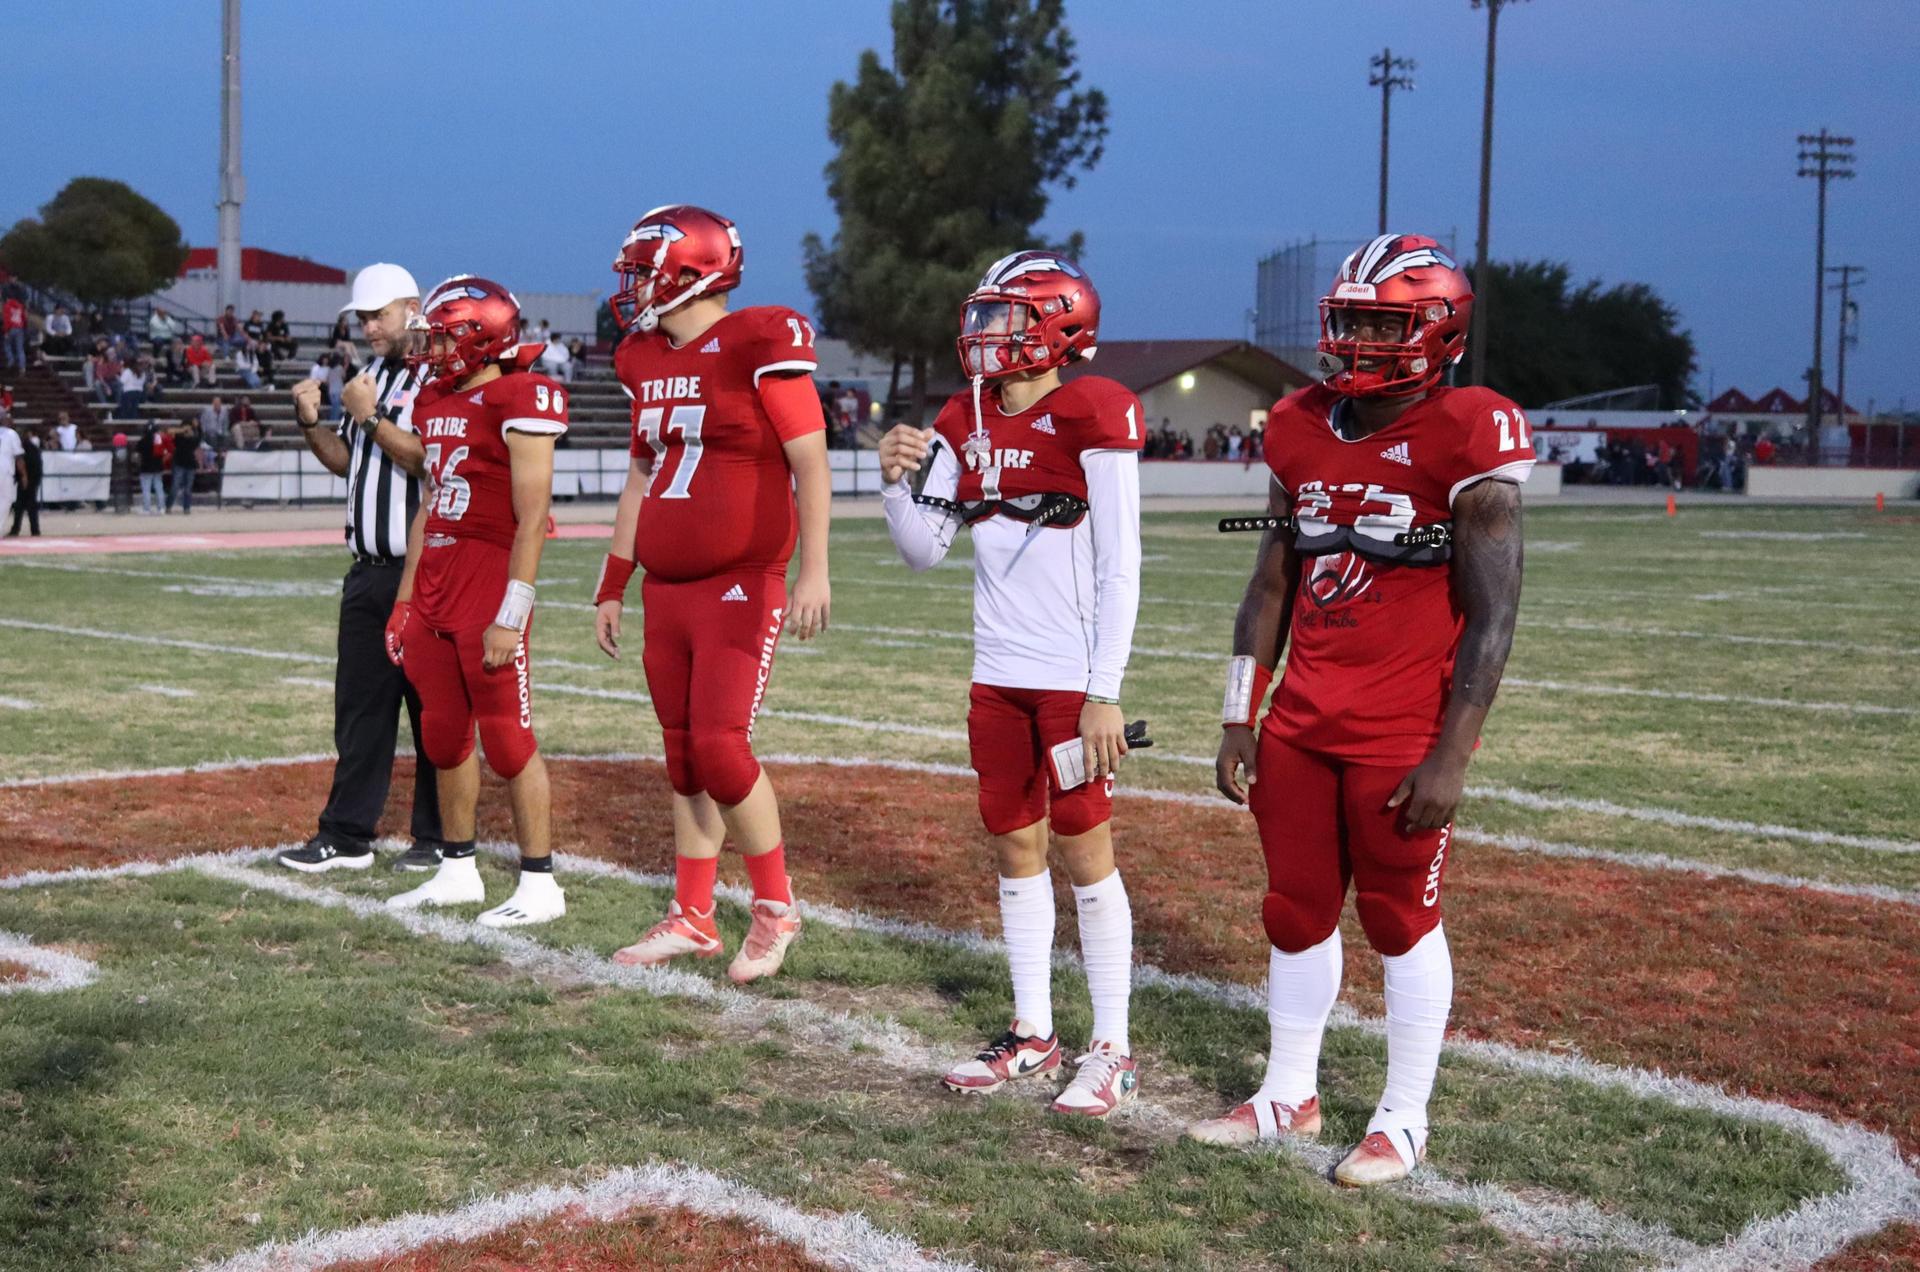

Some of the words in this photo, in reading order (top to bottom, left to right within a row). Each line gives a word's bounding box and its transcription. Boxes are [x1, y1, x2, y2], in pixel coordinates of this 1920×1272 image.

[535, 384, 564, 415] 56
[640, 376, 702, 403] TRIBE
[426, 416, 469, 438] TRIBE
[1125, 403, 1139, 440] 1
[637, 405, 707, 499] 77
